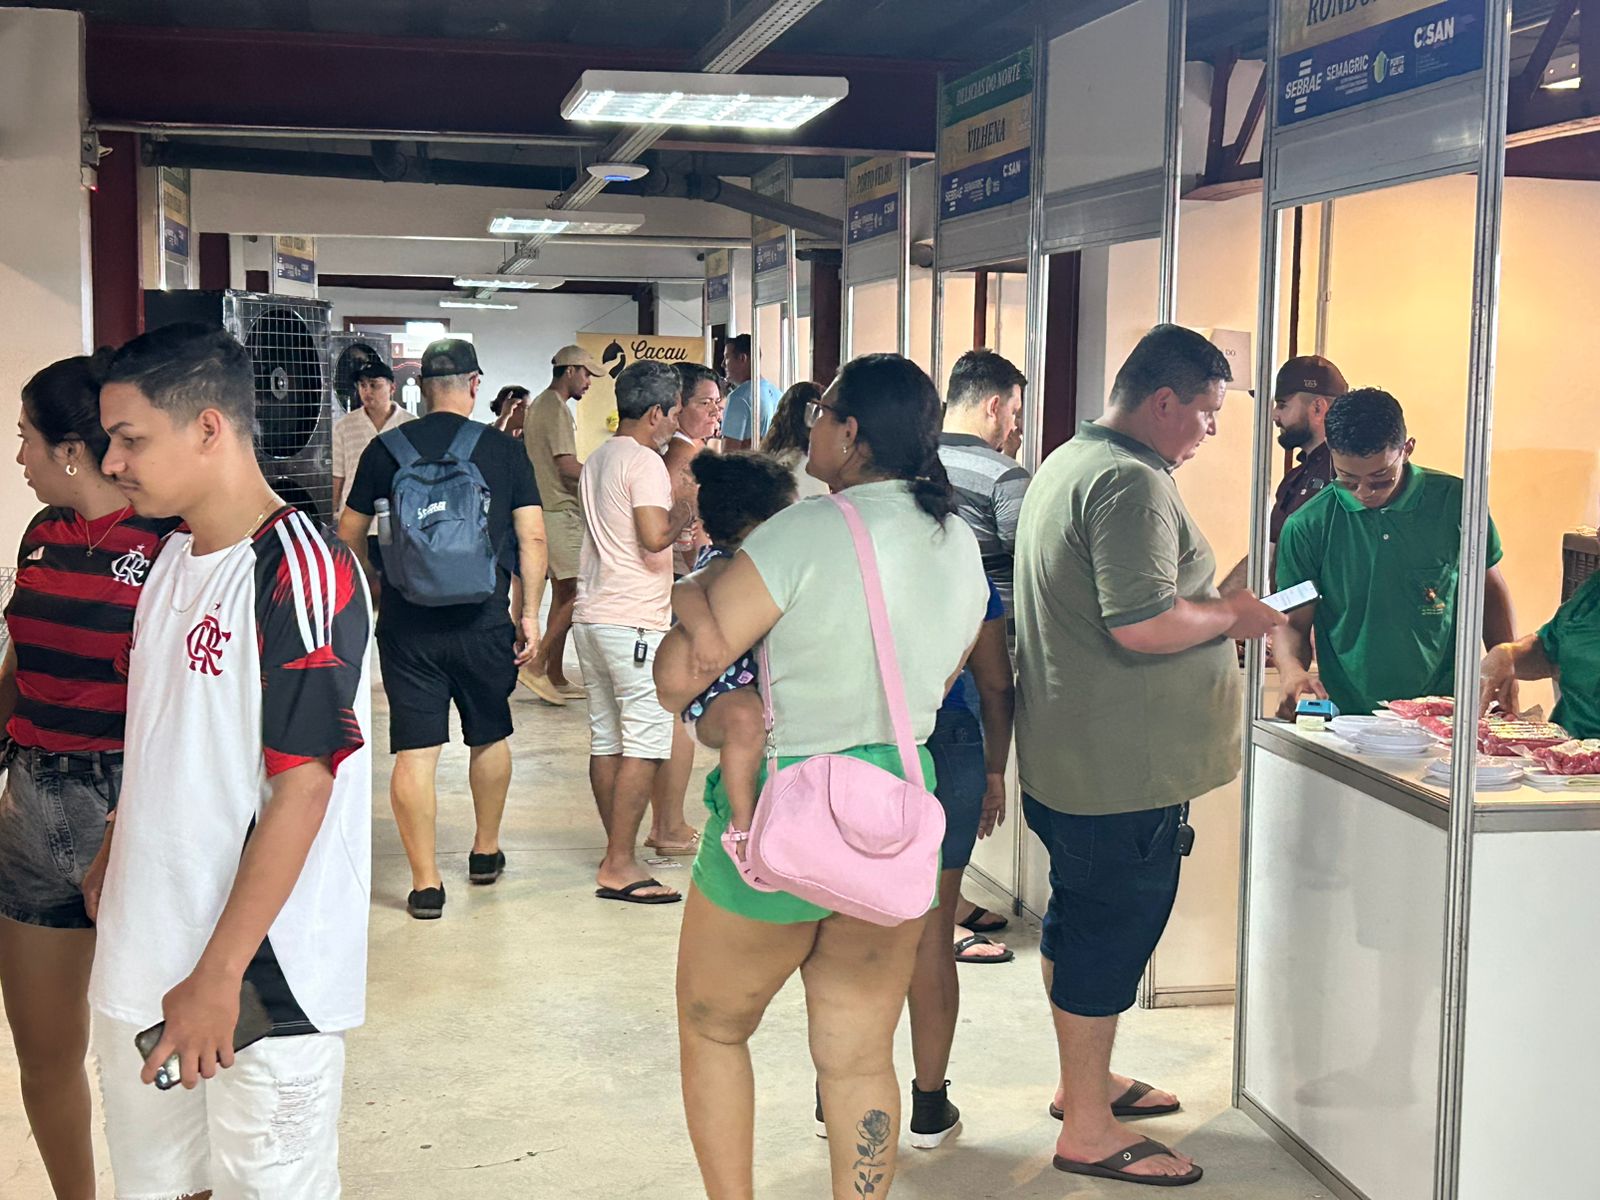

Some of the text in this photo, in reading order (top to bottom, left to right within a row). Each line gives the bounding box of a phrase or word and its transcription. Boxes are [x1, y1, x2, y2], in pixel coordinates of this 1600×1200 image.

[997, 62, 1022, 88] NORTE
[1326, 54, 1369, 81] SEMAGRIC
[1285, 72, 1323, 99] SEBRAE
[968, 118, 1005, 153] VILHENA
[631, 340, 688, 360] Cacau
